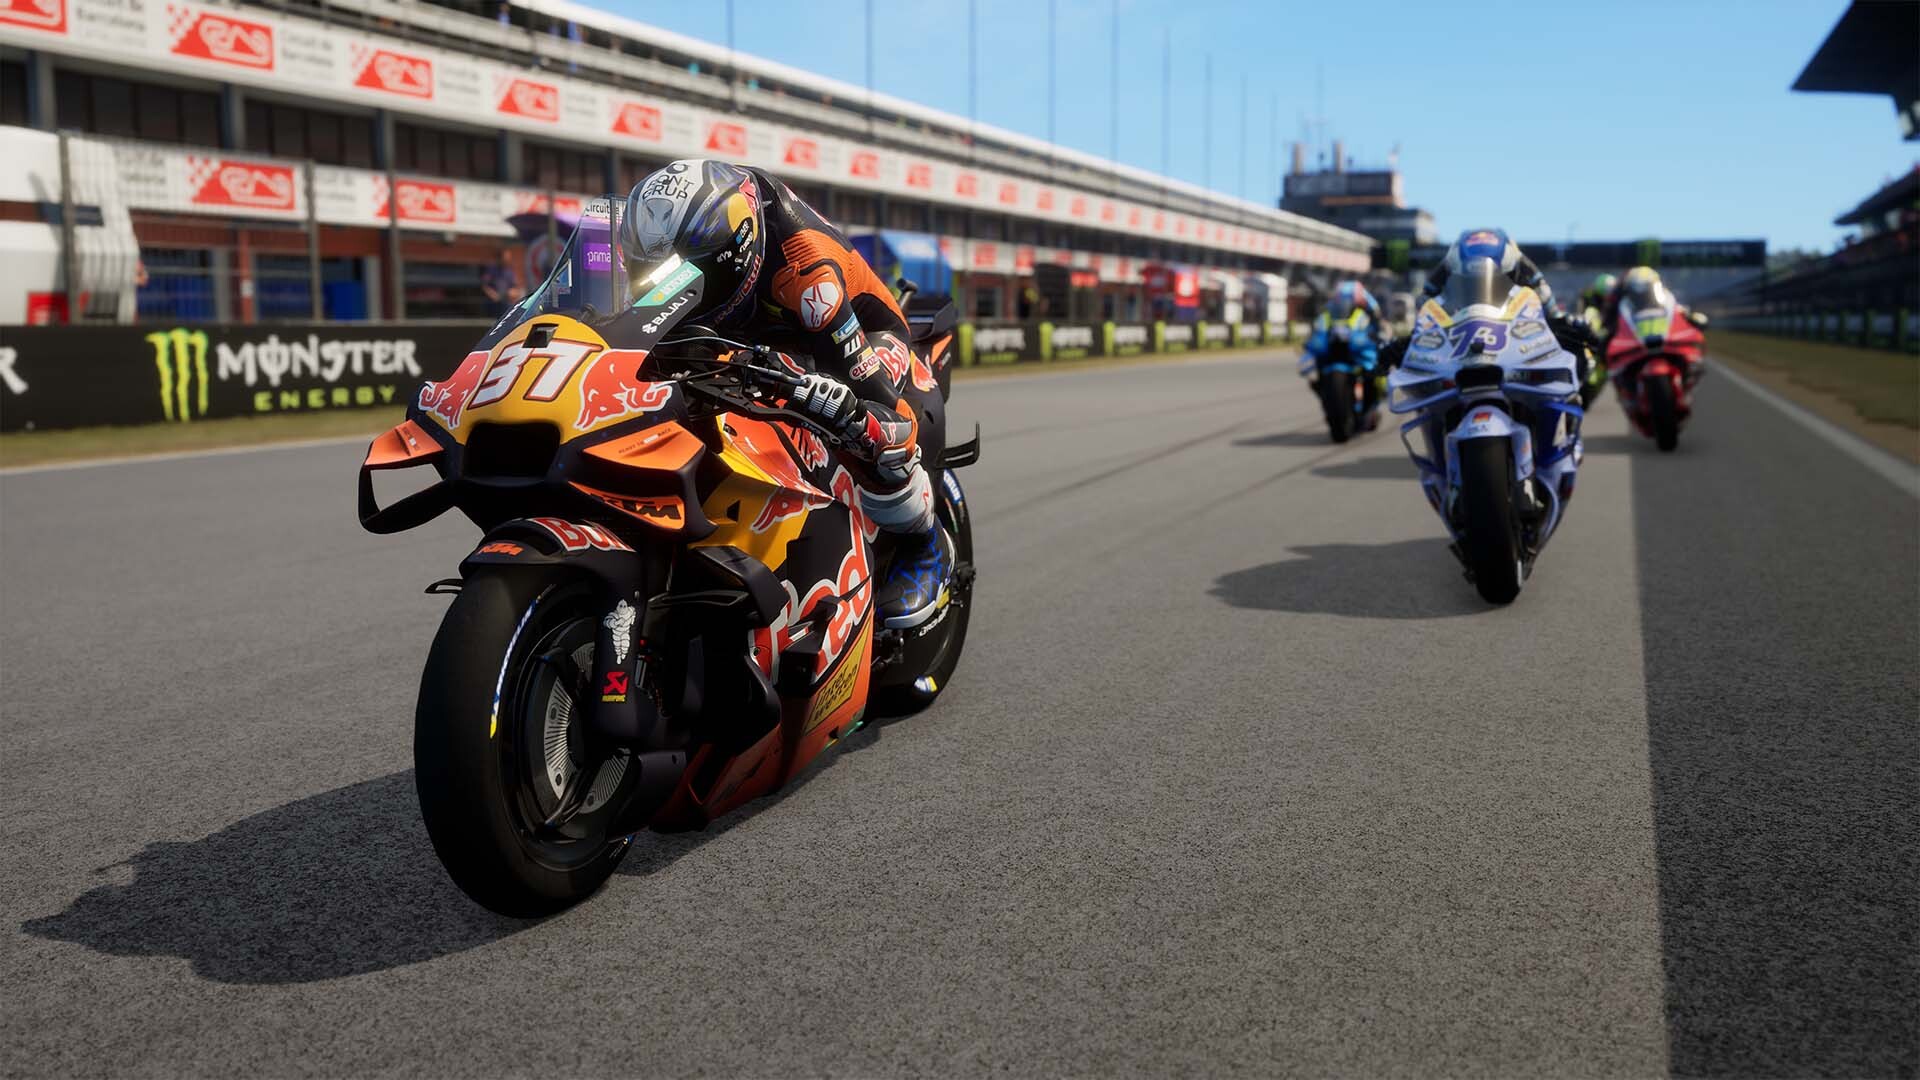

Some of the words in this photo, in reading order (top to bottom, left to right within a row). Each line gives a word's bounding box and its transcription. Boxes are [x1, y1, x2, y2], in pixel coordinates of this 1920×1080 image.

[642, 184, 688, 200] GRUP
[652, 296, 689, 326] BAJAJ
[216, 334, 422, 387] MONSTER
[467, 337, 605, 411] 37
[254, 385, 397, 411] ENERGY
